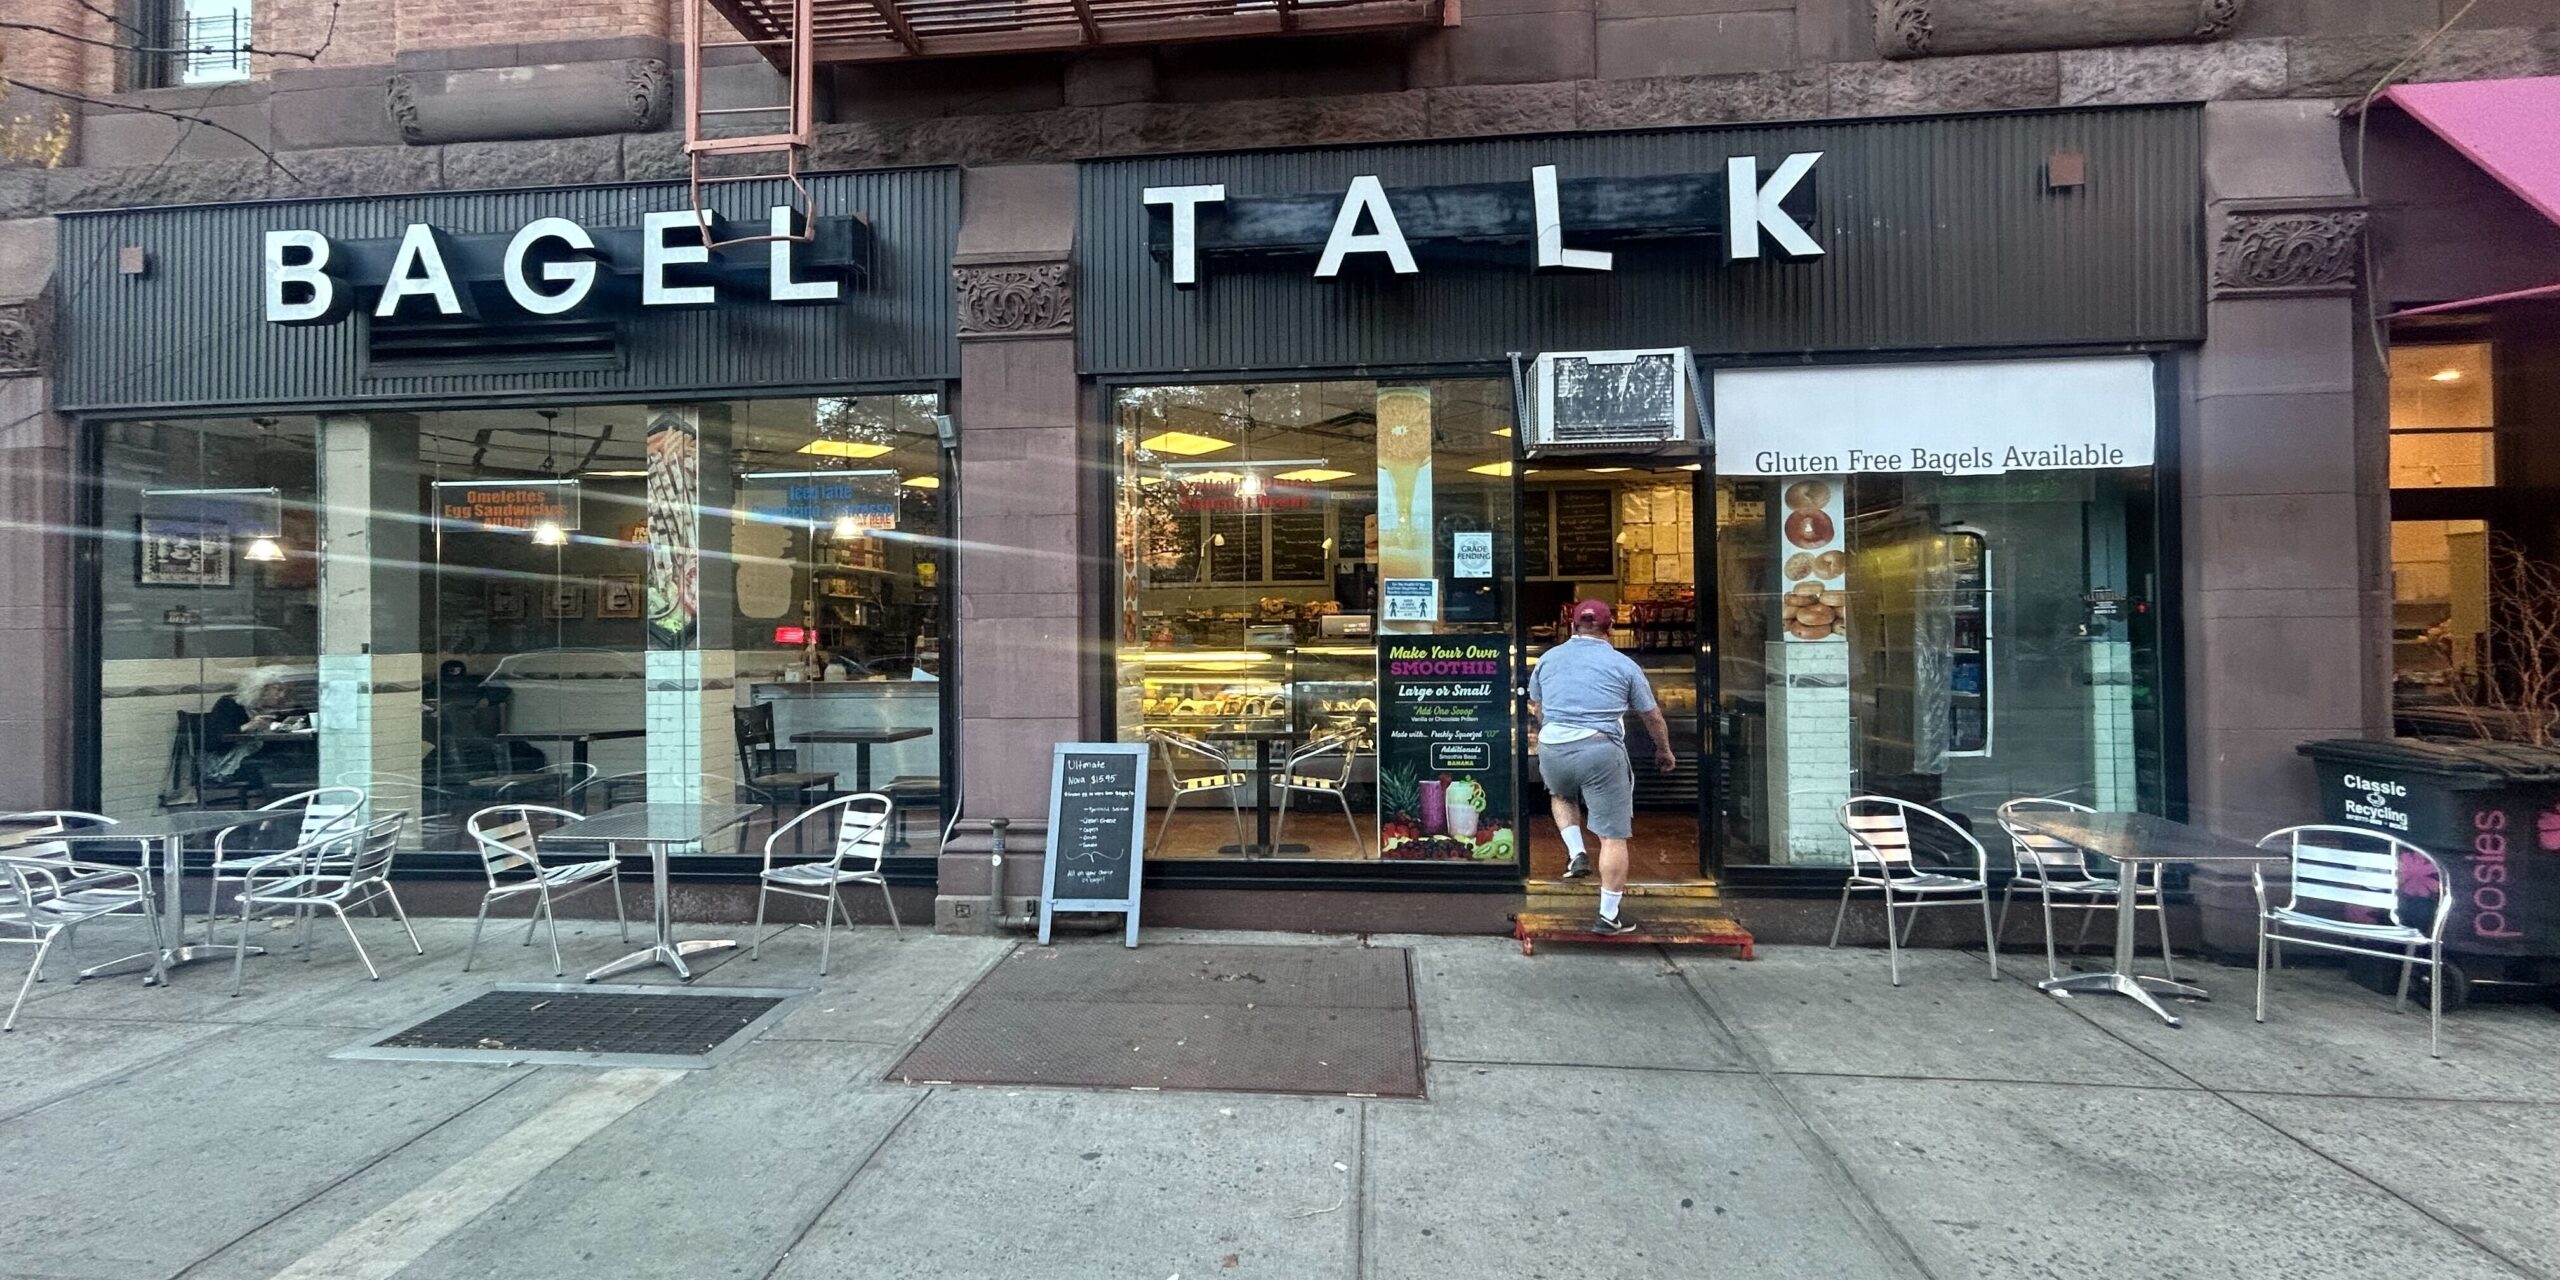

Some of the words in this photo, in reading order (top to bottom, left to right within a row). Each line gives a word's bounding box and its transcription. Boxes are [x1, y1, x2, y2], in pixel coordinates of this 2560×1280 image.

[265, 206, 838, 322] BAGEL
[1144, 152, 1825, 284] TALK
[1755, 450, 1839, 473] Gluten
[1848, 450, 1902, 471] Free
[1911, 447, 1993, 475] Bagels
[2002, 443, 2124, 468] Available
[466, 490, 546, 505] Omelettes
[444, 504, 472, 519] Egg
[474, 503, 568, 518] Sandwiches
[1457, 552, 1491, 560] PENDING
[1460, 545, 1488, 553] GRADE
[1390, 645, 1428, 659] Make
[1431, 645, 1463, 659] Your
[1466, 645, 1500, 659] Own
[1390, 660, 1498, 676] SMOOTHIE
[1398, 685, 1434, 701] Large
[1435, 686, 1451, 696] or
[1452, 684, 1492, 696] Small
[1433, 705, 1450, 716] One
[1390, 730, 1408, 738] Made
[1430, 730, 1454, 741] Freshly
[1454, 730, 1482, 741] Squeezed
[1440, 745, 1482, 753] Additionals
[1067, 776, 1086, 786] Nova
[2344, 774, 2407, 798] Classic
[2345, 799, 2408, 826] Recycling
[2464, 810, 2524, 937] posies
